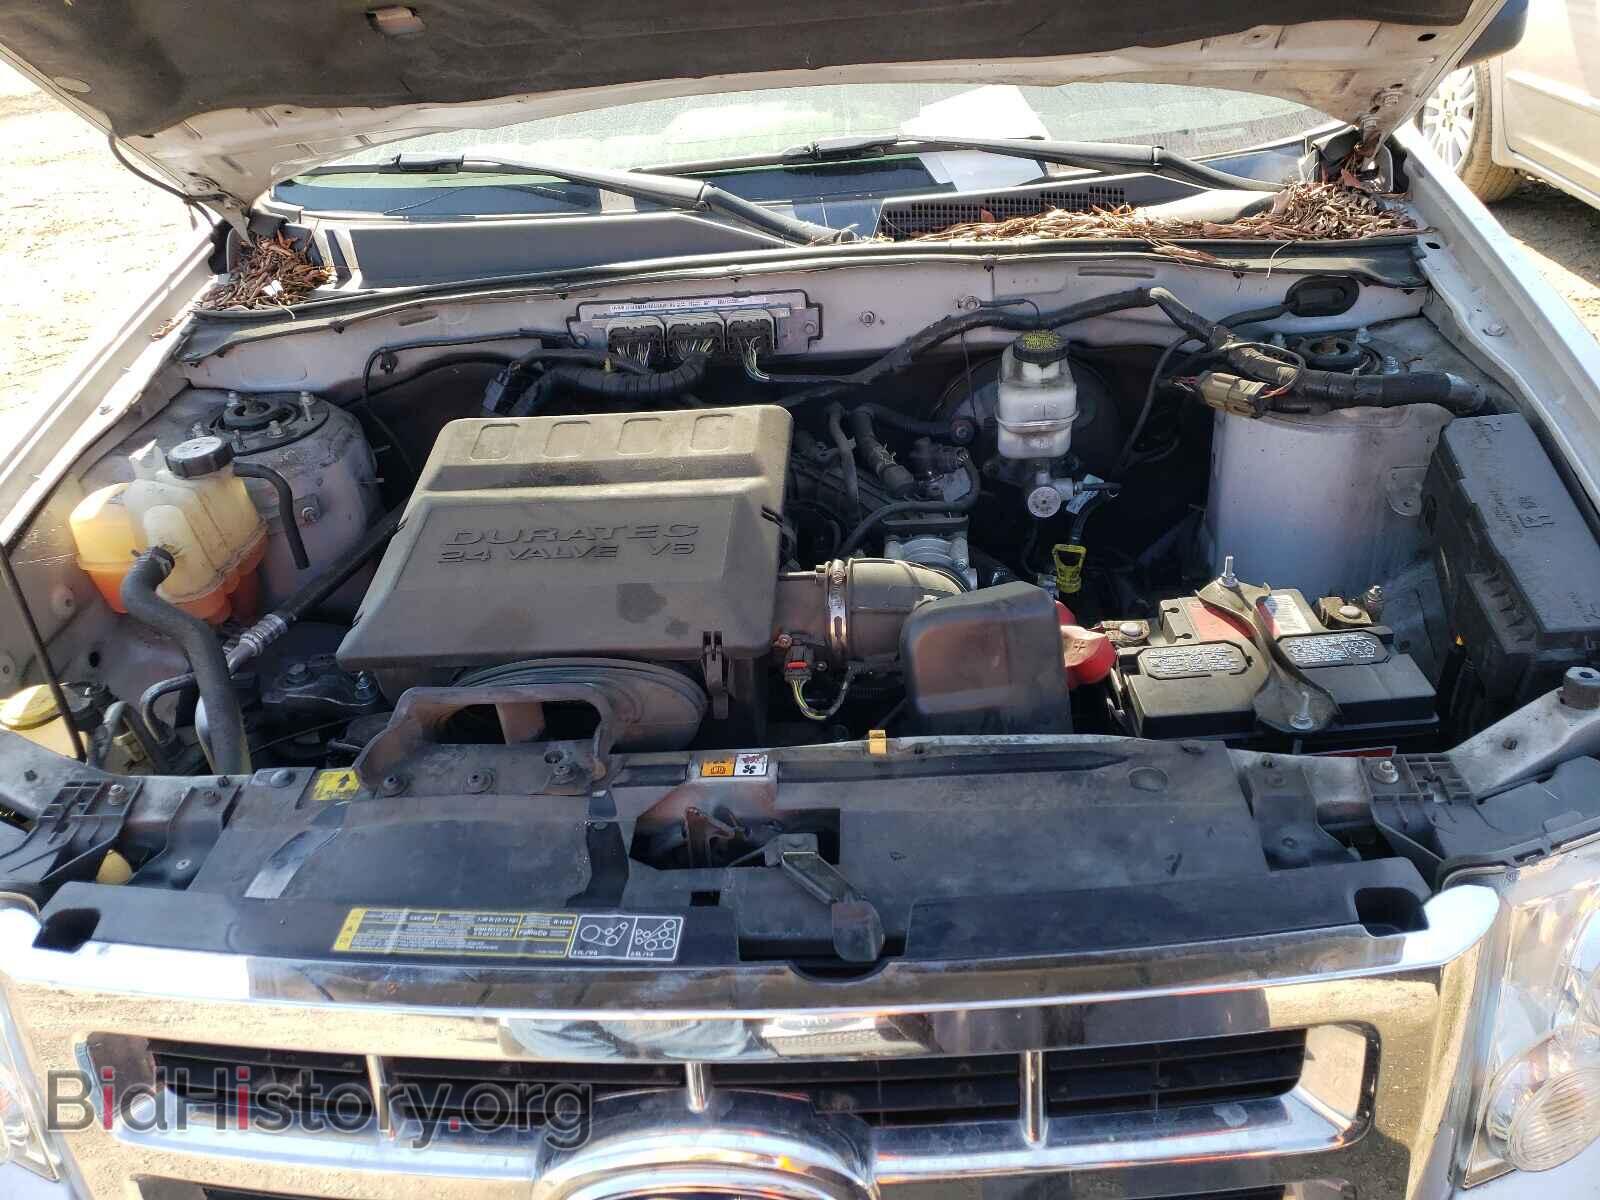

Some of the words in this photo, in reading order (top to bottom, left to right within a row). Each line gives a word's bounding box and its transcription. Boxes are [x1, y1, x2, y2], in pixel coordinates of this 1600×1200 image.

[443, 524, 700, 546] DURATEC
[437, 549, 492, 564] 24
[508, 544, 620, 561] VALVE
